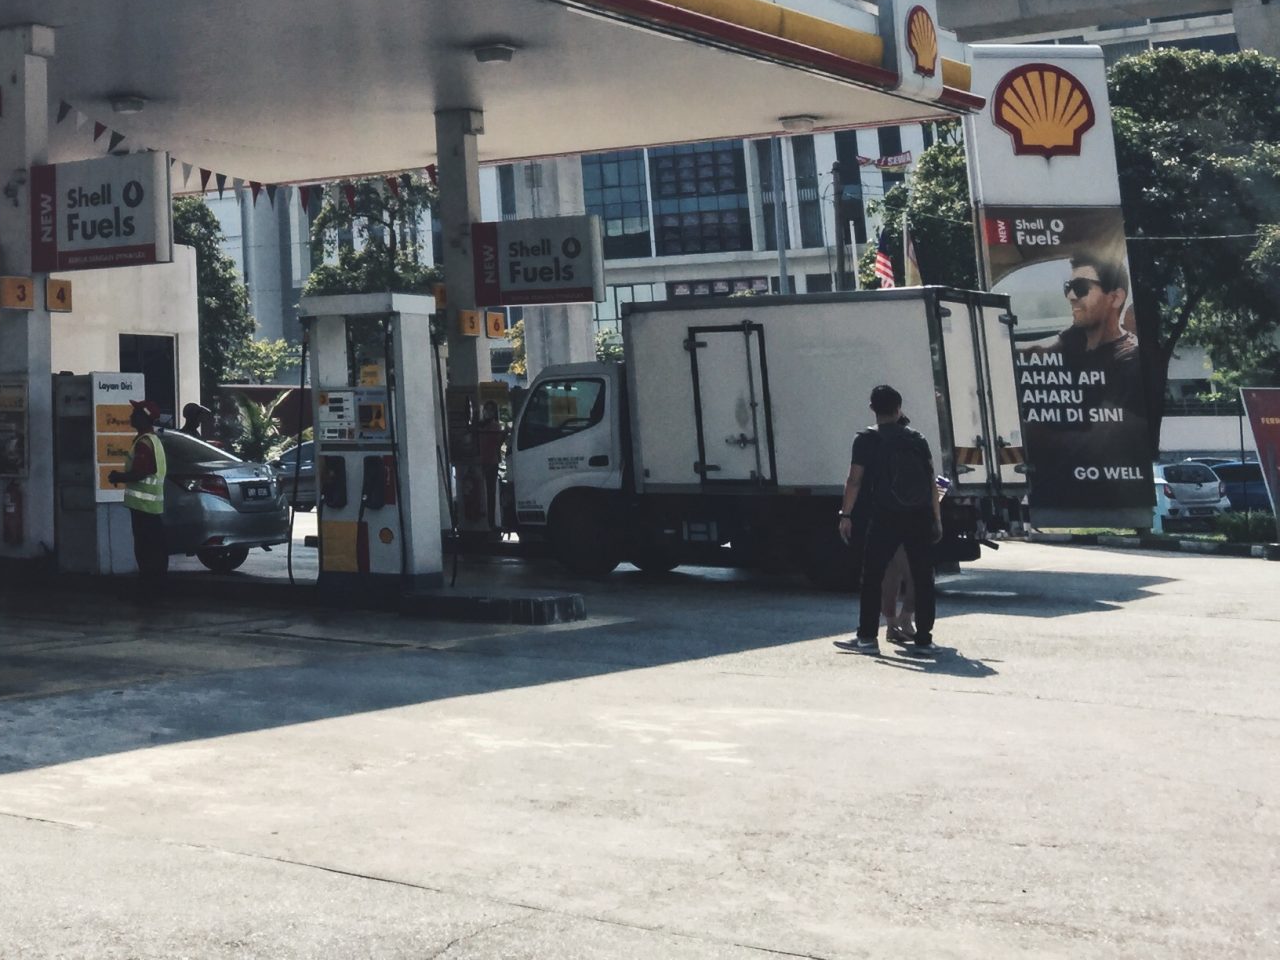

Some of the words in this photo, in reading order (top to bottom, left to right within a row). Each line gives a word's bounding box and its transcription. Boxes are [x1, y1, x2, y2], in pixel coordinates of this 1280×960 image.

[67, 183, 111, 208] Shell
[40, 193, 53, 243] NEW
[67, 206, 135, 241] Fuels
[1015, 218, 1044, 230] Shell
[996, 219, 1008, 243] NEW
[1016, 230, 1061, 245] Fuels
[508, 238, 552, 258] Shell
[482, 244, 497, 284] NEW
[509, 257, 575, 283] Fuels
[16, 285, 26, 302] 3
[56, 287, 66, 303] 4
[469, 316, 475, 330] 5
[493, 318, 500, 332] 6
[1021, 371, 1072, 385] AHAN
[1078, 371, 1106, 385] API
[98, 381, 119, 392] Layan
[120, 381, 133, 391] Diri
[1023, 389, 1083, 403] AHARU
[1023, 408, 1061, 422] AMI
[1066, 408, 1084, 422] DI
[1074, 466, 1100, 480] GO
[1104, 466, 1144, 480] WELL
